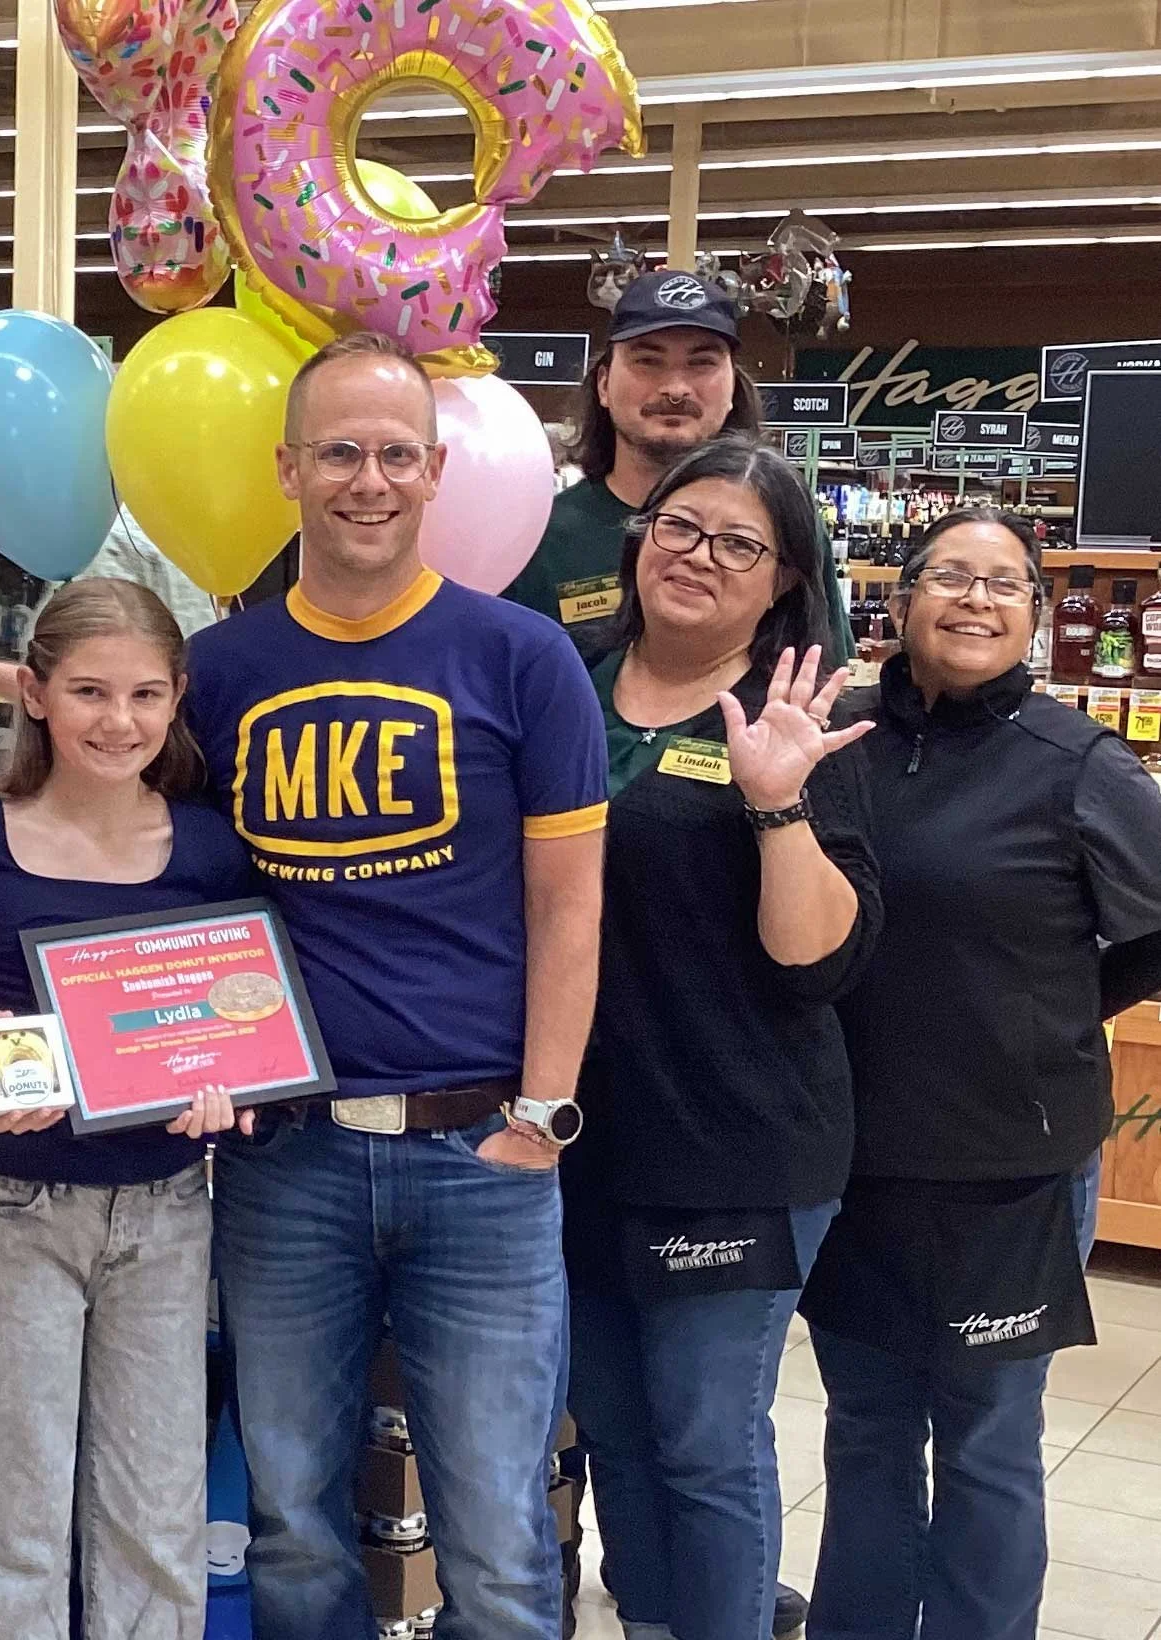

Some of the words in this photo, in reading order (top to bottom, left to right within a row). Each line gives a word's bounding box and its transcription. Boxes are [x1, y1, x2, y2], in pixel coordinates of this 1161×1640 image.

[534, 351, 554, 367] GIN
[838, 338, 1041, 425] Hagg
[793, 397, 829, 412] SCOTCH
[980, 423, 1008, 435] SYRAH
[1051, 433, 1080, 446] MERLO
[576, 595, 608, 611] Jacob
[264, 720, 416, 822] MKE
[676, 755, 722, 771] Lindah
[344, 844, 454, 880] COMPANY
[64, 946, 136, 966] Haggen
[134, 931, 206, 956] COMMUNITY
[209, 925, 251, 946] GIVING
[60, 969, 114, 987] OFFICIAL
[116, 962, 164, 979] HAGGEN
[166, 956, 206, 972] DONUT
[207, 948, 266, 966] INVENTOR
[154, 1004, 203, 1026] Lydia
[8, 1081, 49, 1093] DONUTS
[649, 1236, 757, 1258] Haggen
[948, 1304, 1049, 1332] Haggen
